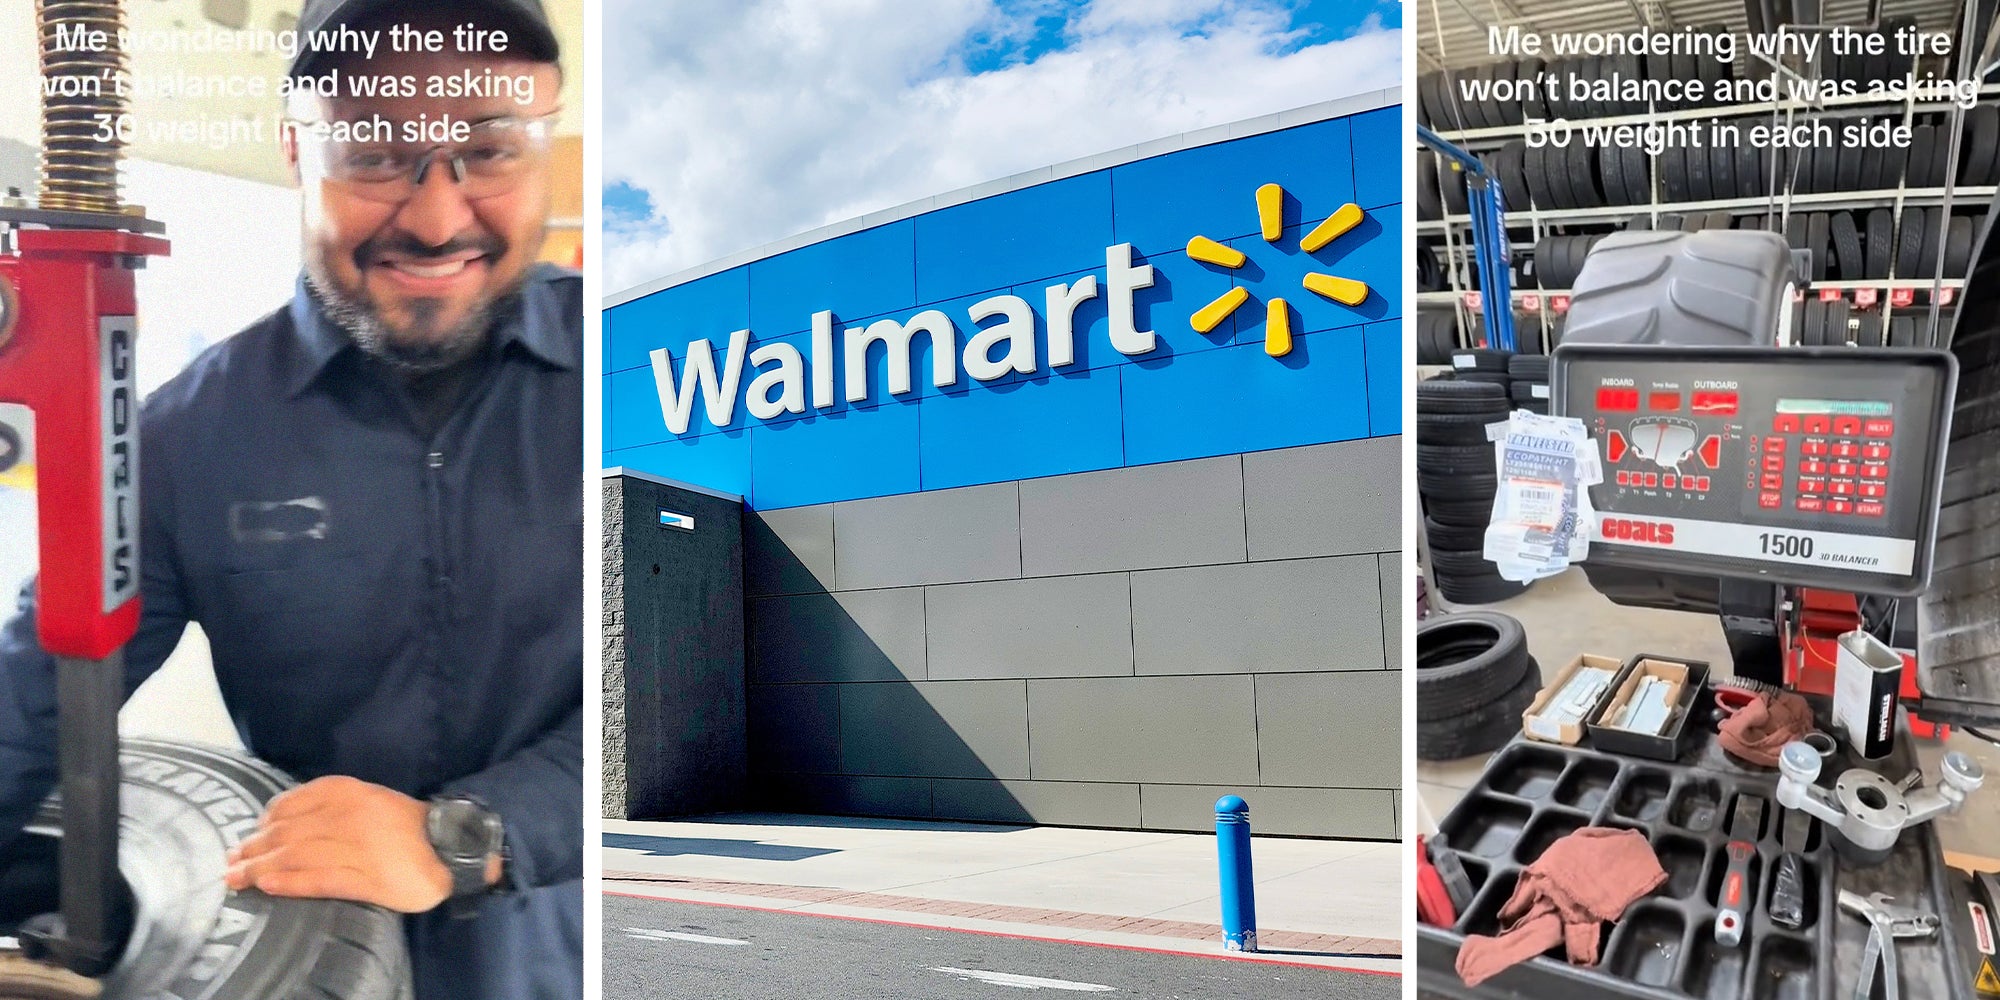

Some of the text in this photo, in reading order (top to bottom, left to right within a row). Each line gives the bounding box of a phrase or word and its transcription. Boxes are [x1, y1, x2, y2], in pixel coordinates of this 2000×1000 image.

[649, 242, 1156, 435] Walmart
[1693, 381, 1738, 390] OUTBOARD
[1758, 532, 1879, 567] 1500 3D BALANCER
